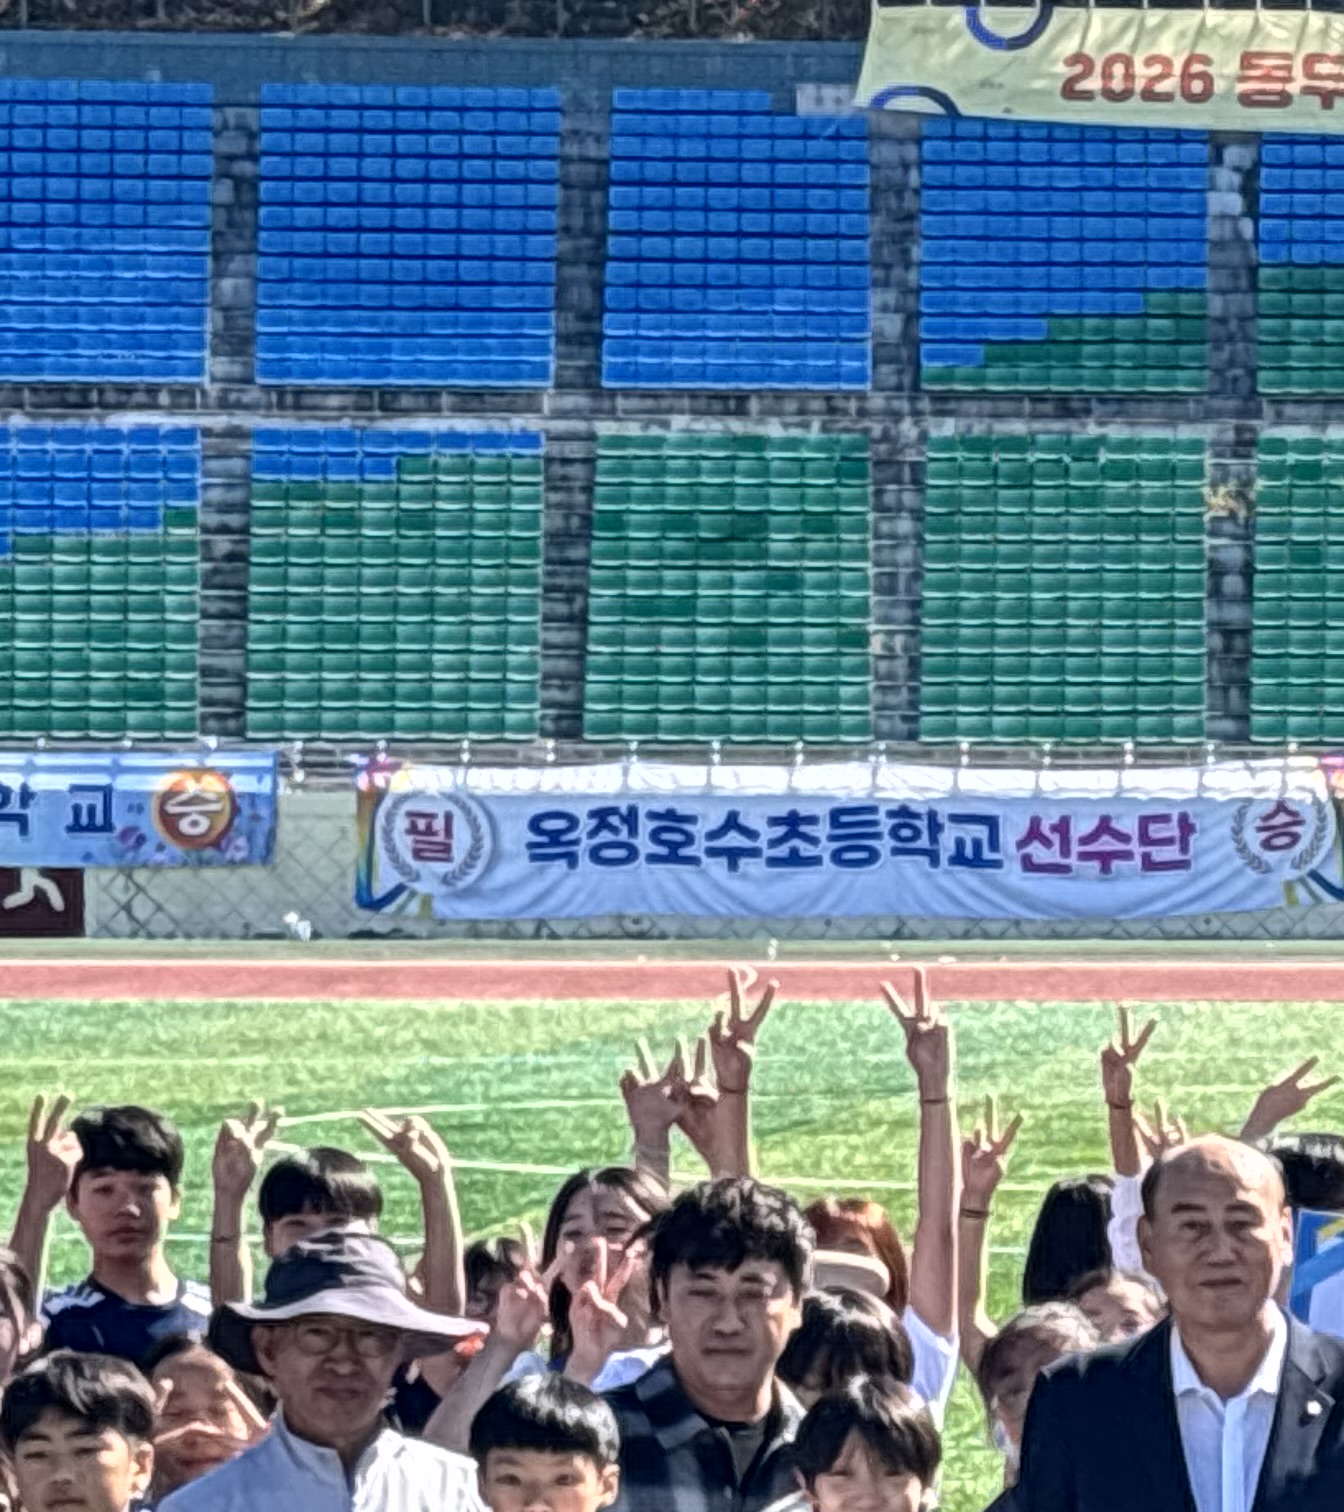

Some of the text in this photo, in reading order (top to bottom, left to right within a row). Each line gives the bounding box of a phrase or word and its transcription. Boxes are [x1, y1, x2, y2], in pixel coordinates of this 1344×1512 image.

[1061, 52, 1215, 103] 2026
[404, 809, 455, 863] 필
[525, 803, 1197, 875] 옥정호수초등학교 선수단
[1254, 798, 1307, 853] 승
